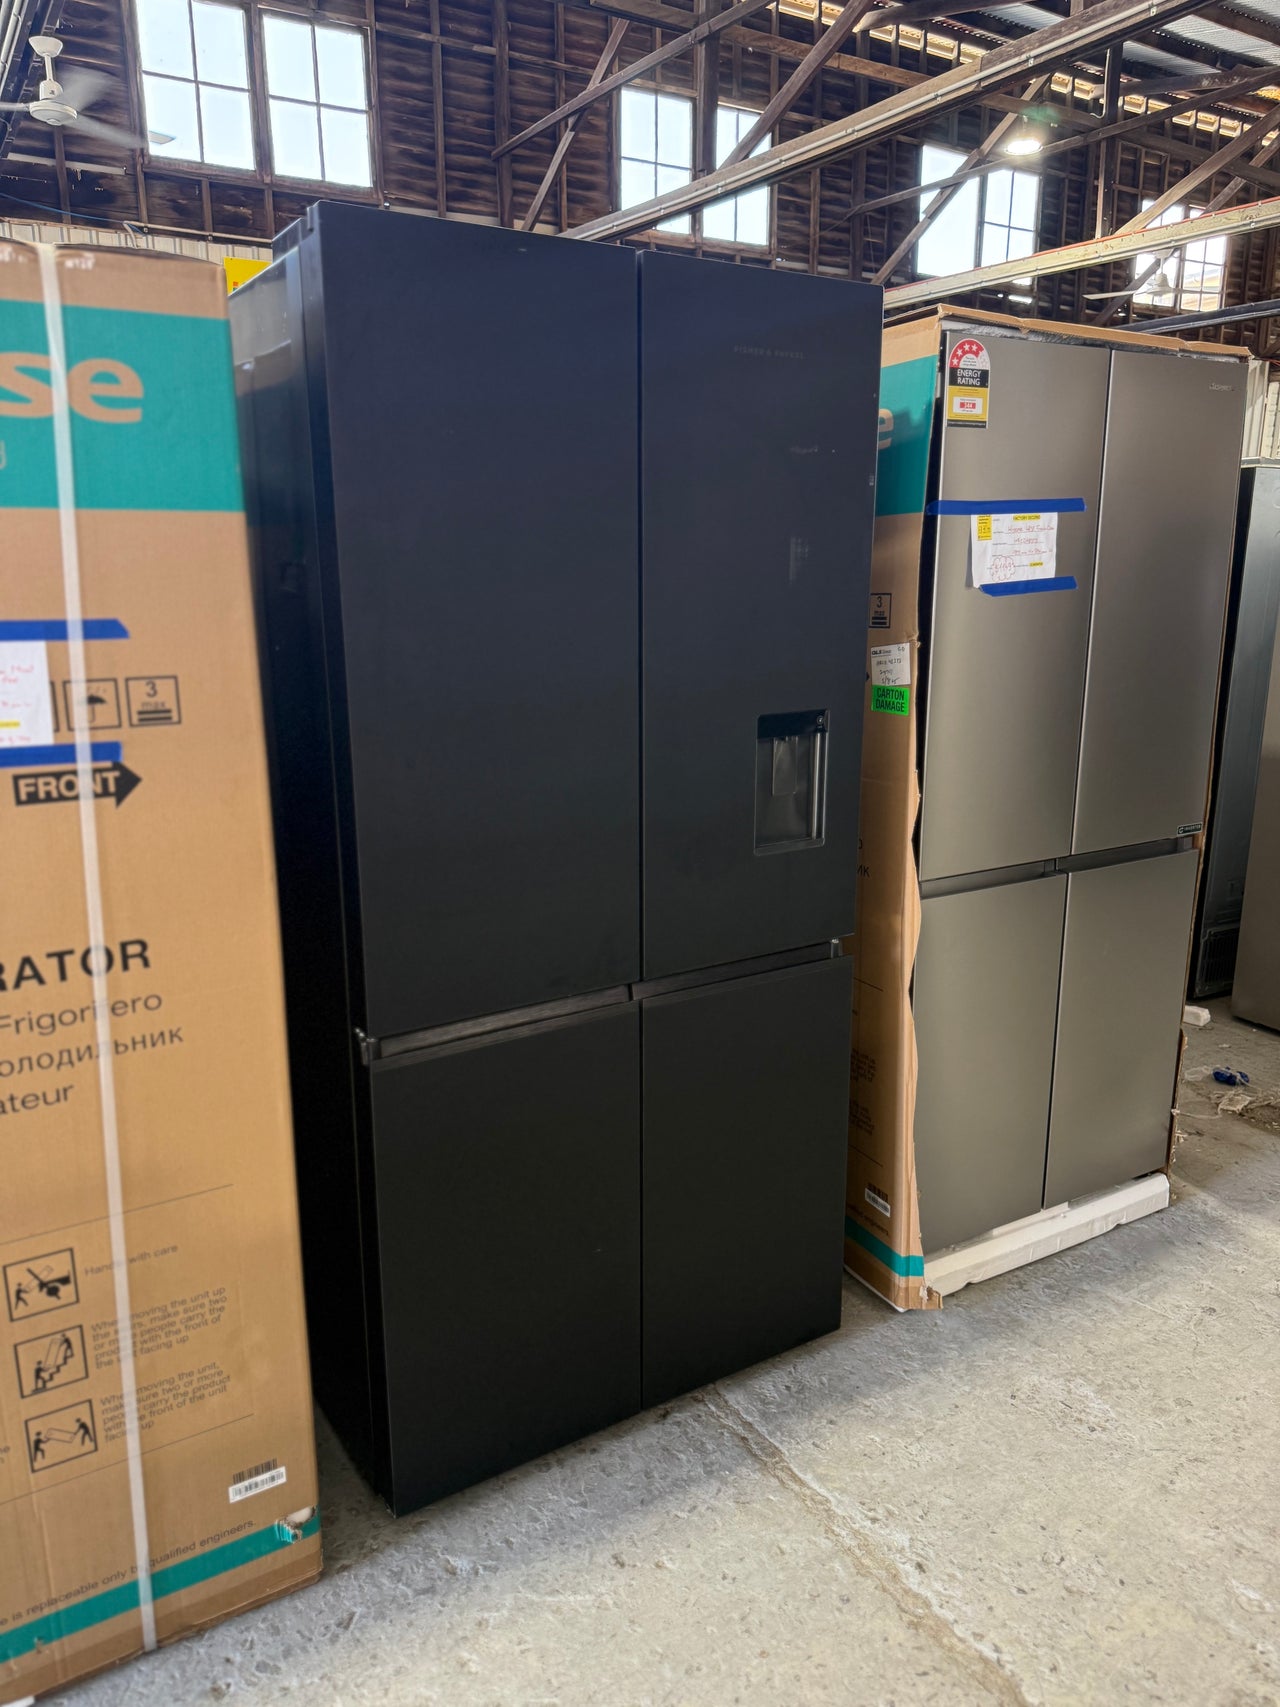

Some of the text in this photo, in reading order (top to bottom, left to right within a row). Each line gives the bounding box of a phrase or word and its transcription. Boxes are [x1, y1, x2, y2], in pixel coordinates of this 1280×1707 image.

[957, 369, 981, 378] ENERGY
[957, 377, 981, 386] RATING
[876, 595, 883, 608] 3
[145, 681, 158, 698] 3
[876, 688, 905, 701] CARTON
[141, 701, 166, 709] max
[875, 699, 905, 712] DAMAGE
[0, 939, 151, 992] ATOR
[170, 1298, 187, 1309] the
[190, 1291, 210, 1304] unit
[212, 1287, 226, 1298] up
[92, 1331, 110, 1343] the
[150, 1310, 180, 1325] make
[182, 1301, 206, 1314] sure
[208, 1295, 228, 1306] two
[139, 1332, 161, 1346] with
[164, 1327, 182, 1339] the
[184, 1318, 208, 1333] front
[211, 1313, 222, 1324] of
[140, 1321, 176, 1338] people
[179, 1311, 206, 1325] carry
[208, 1304, 225, 1316] the
[175, 1335, 189, 1346] up
[136, 1376, 175, 1394] moving
[177, 1369, 194, 1381] the
[143, 1397, 169, 1411] carry
[172, 1389, 189, 1401] the
[192, 1375, 231, 1395] product
[161, 1385, 180, 1396] two
[197, 1369, 224, 1383] more
[149, 1403, 174, 1418] front
[175, 1399, 187, 1409] of
[188, 1392, 205, 1404] the
[208, 1385, 228, 1398] unit
[12, 1611, 23, 1622] is
[26, 1580, 99, 1616] replaceable
[102, 1570, 127, 1586] only
[149, 1541, 196, 1568] qualified
[199, 1519, 257, 1547] engineers.
